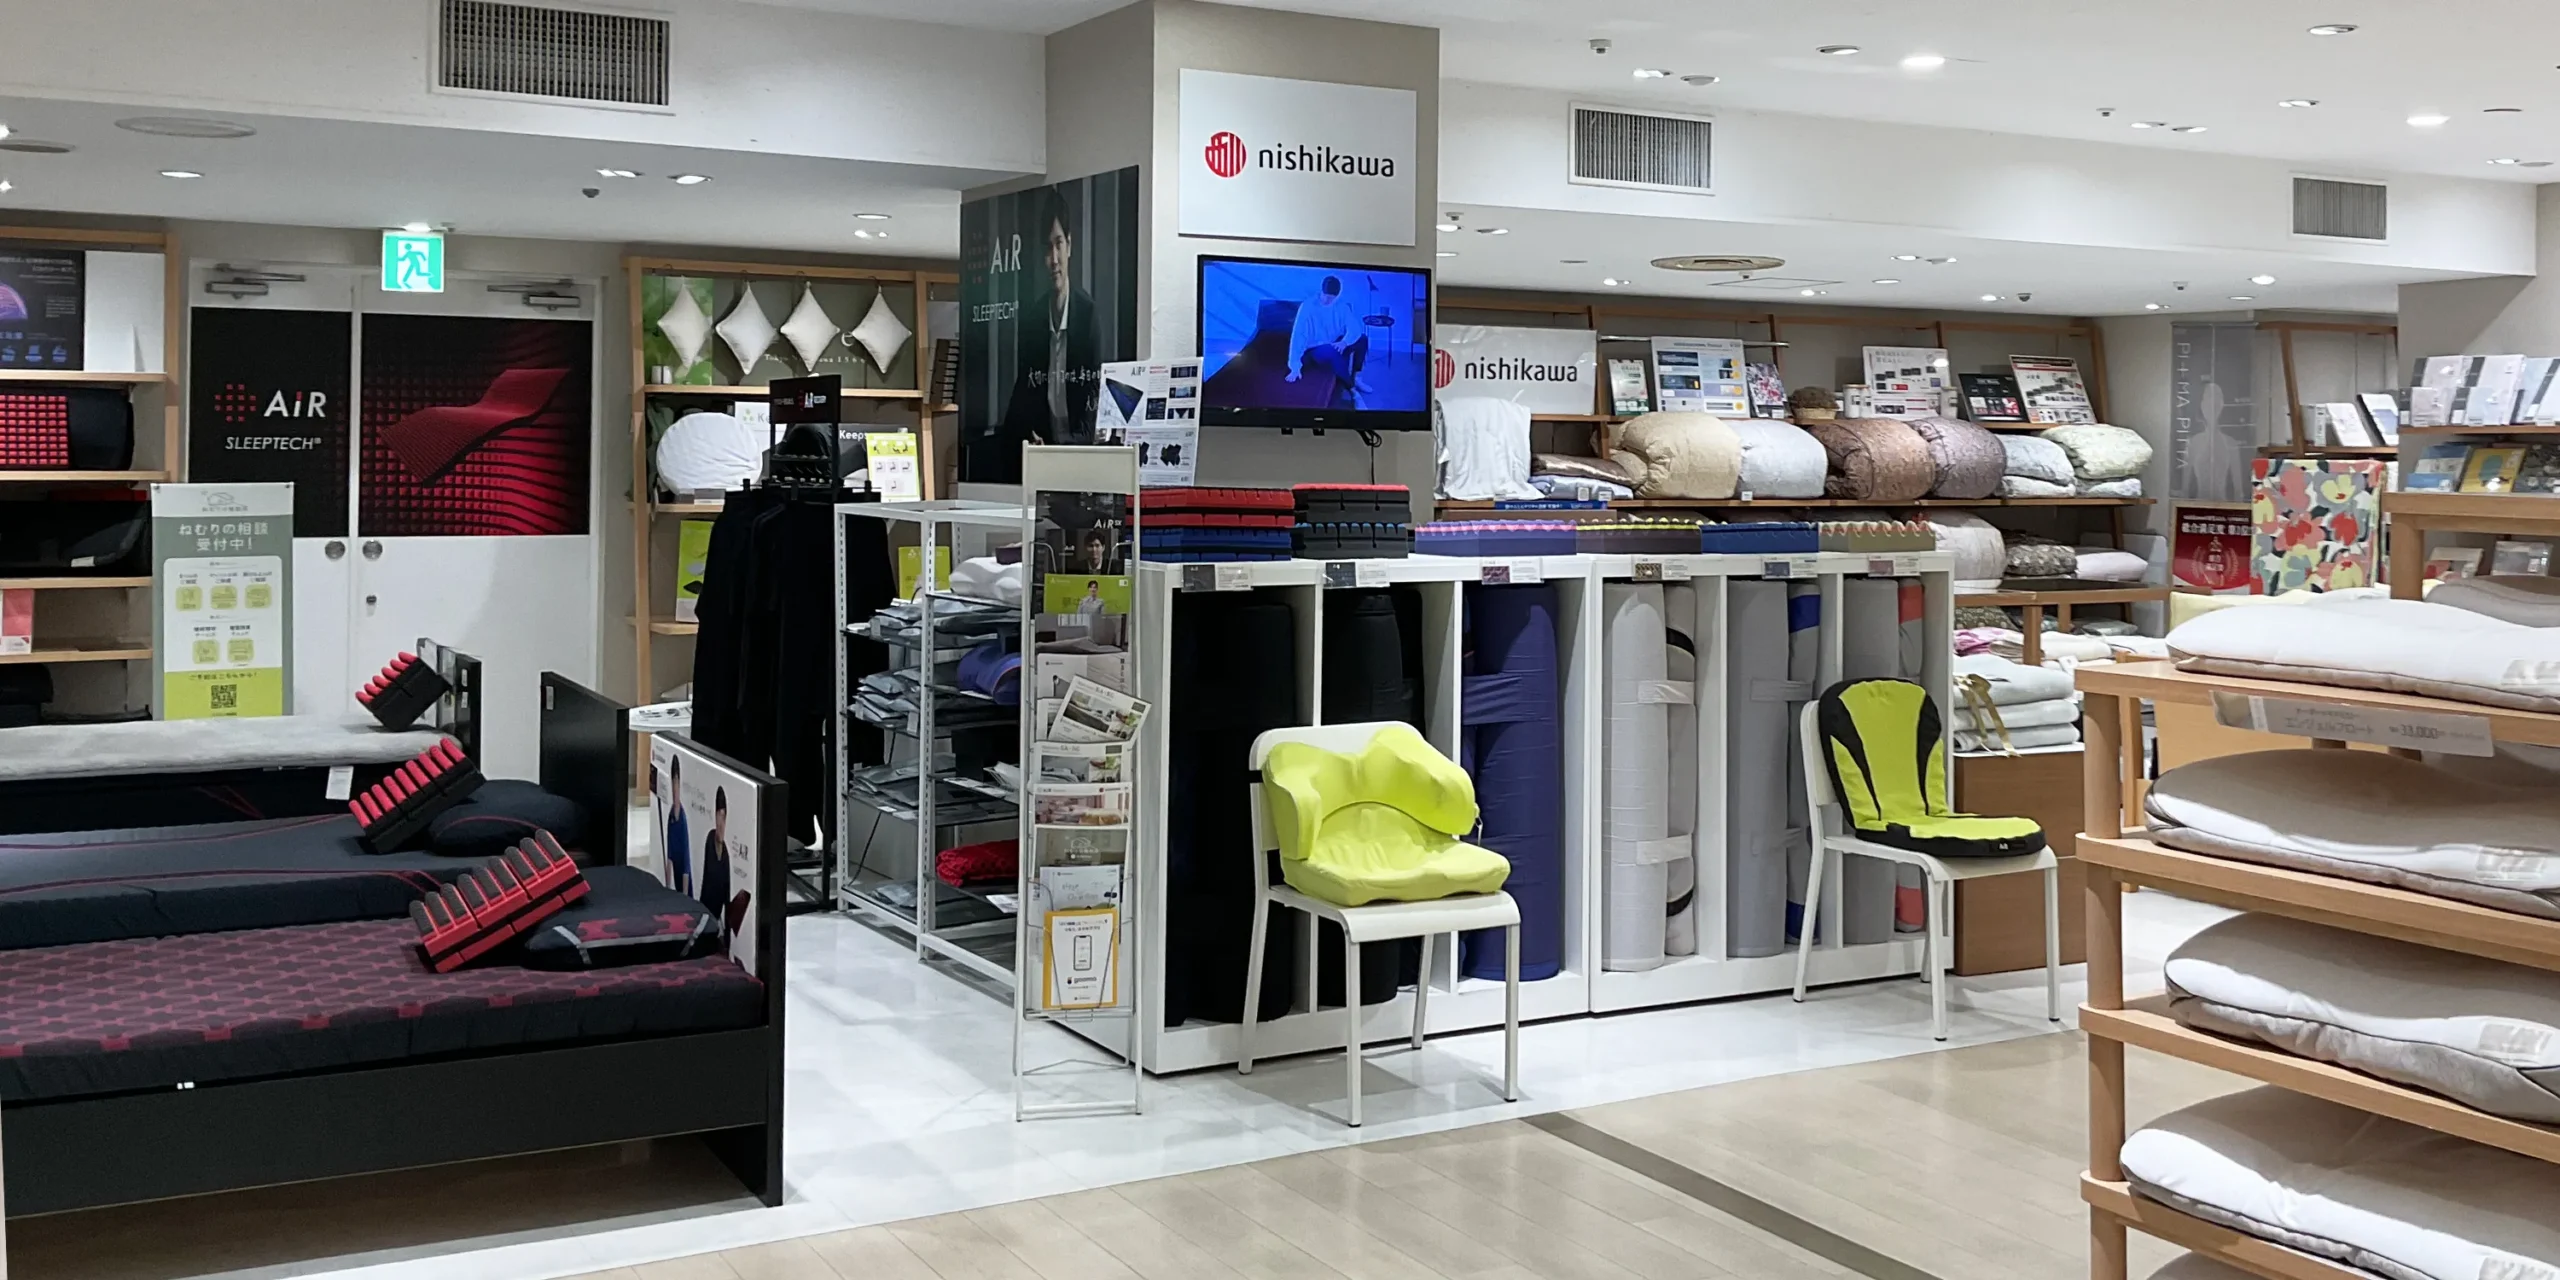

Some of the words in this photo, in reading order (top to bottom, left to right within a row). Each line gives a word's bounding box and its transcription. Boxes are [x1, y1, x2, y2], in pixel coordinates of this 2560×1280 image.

[1258, 143, 1394, 177] nishikawa
[1464, 357, 1578, 382] nishikawa
[263, 389, 327, 418] AiR
[178, 522, 268, 536] ねむりの相談
